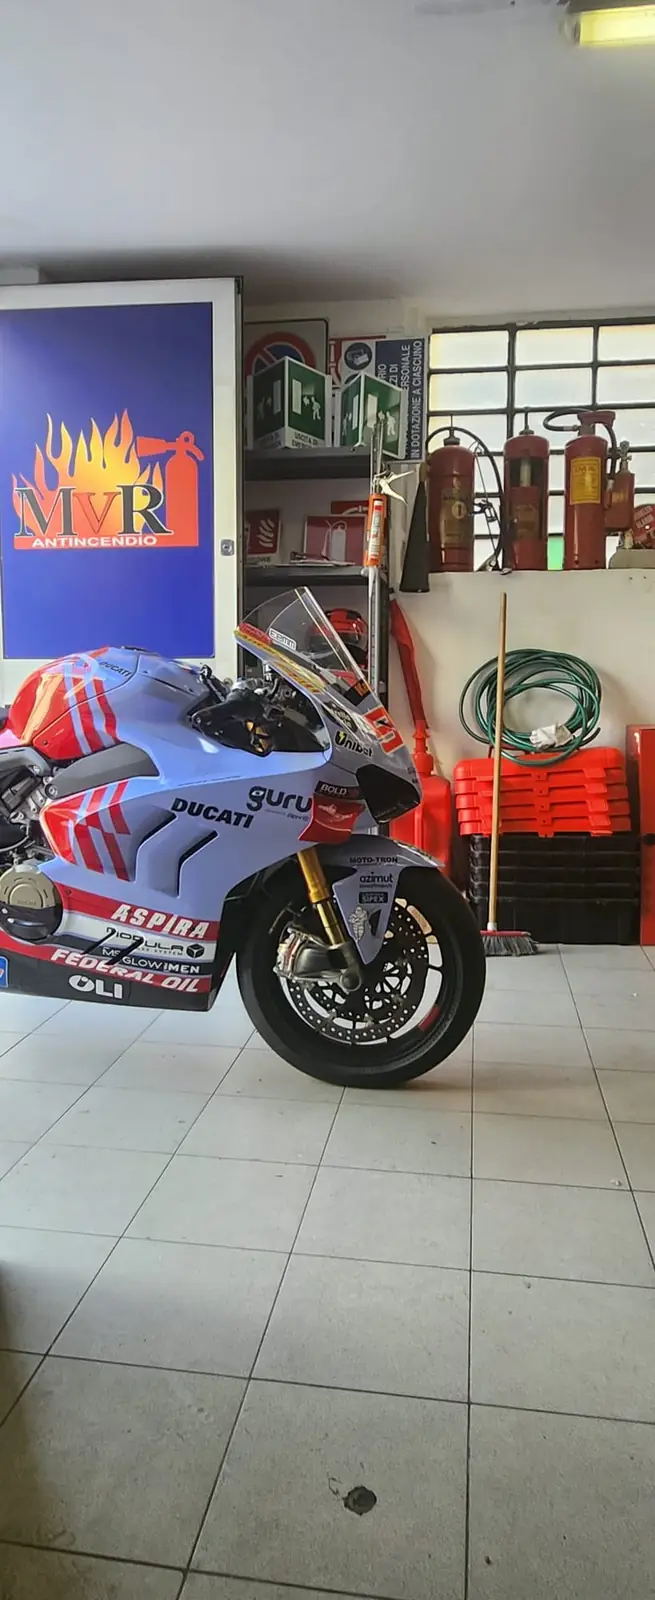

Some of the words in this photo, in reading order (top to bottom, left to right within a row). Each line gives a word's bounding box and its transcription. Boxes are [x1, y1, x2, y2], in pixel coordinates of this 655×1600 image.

[412, 341, 422, 386] CIASCUNO
[412, 387, 422, 395] A
[411, 397, 422, 447] DOTAZIONE
[411, 449, 421, 458] IN
[32, 537, 157, 547] ANTINCENDIO
[100, 661, 132, 677] DUCATI
[319, 783, 347, 796] BOLD
[246, 786, 312, 813] guru
[171, 797, 254, 828] DUCATI
[360, 871, 393, 883] azimut
[111, 903, 209, 939] ASPIRA
[51, 949, 155, 984] FEDERAL
[161, 976, 200, 992] OIL
[122, 956, 163, 969] GLOW
